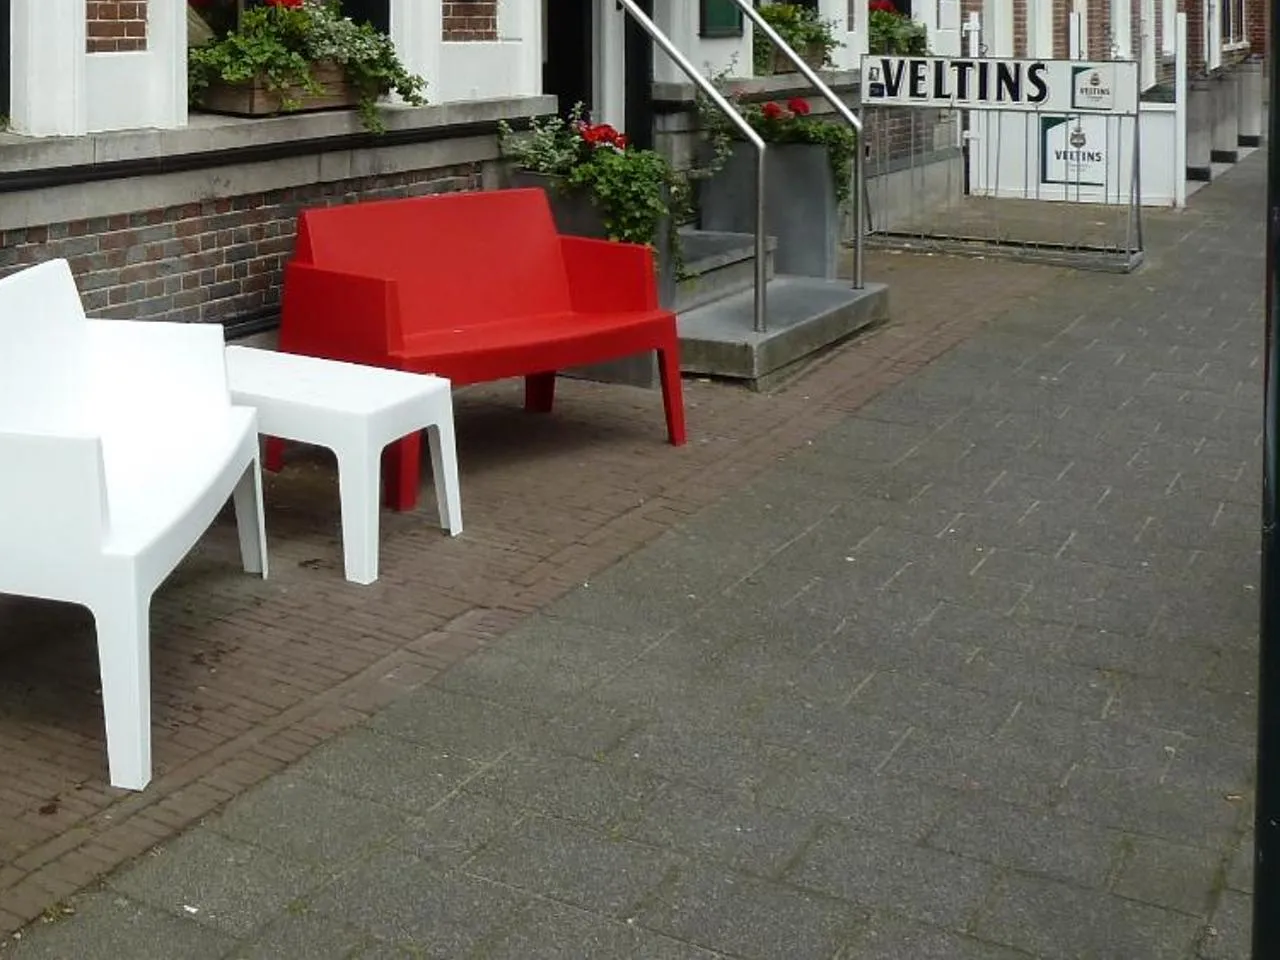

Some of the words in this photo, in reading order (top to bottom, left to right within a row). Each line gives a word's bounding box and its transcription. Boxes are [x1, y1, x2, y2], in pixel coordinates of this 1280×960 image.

[880, 59, 1048, 103] VELTINS
[1080, 87, 1111, 96] VELTINS
[1055, 150, 1102, 162] VELTINS
